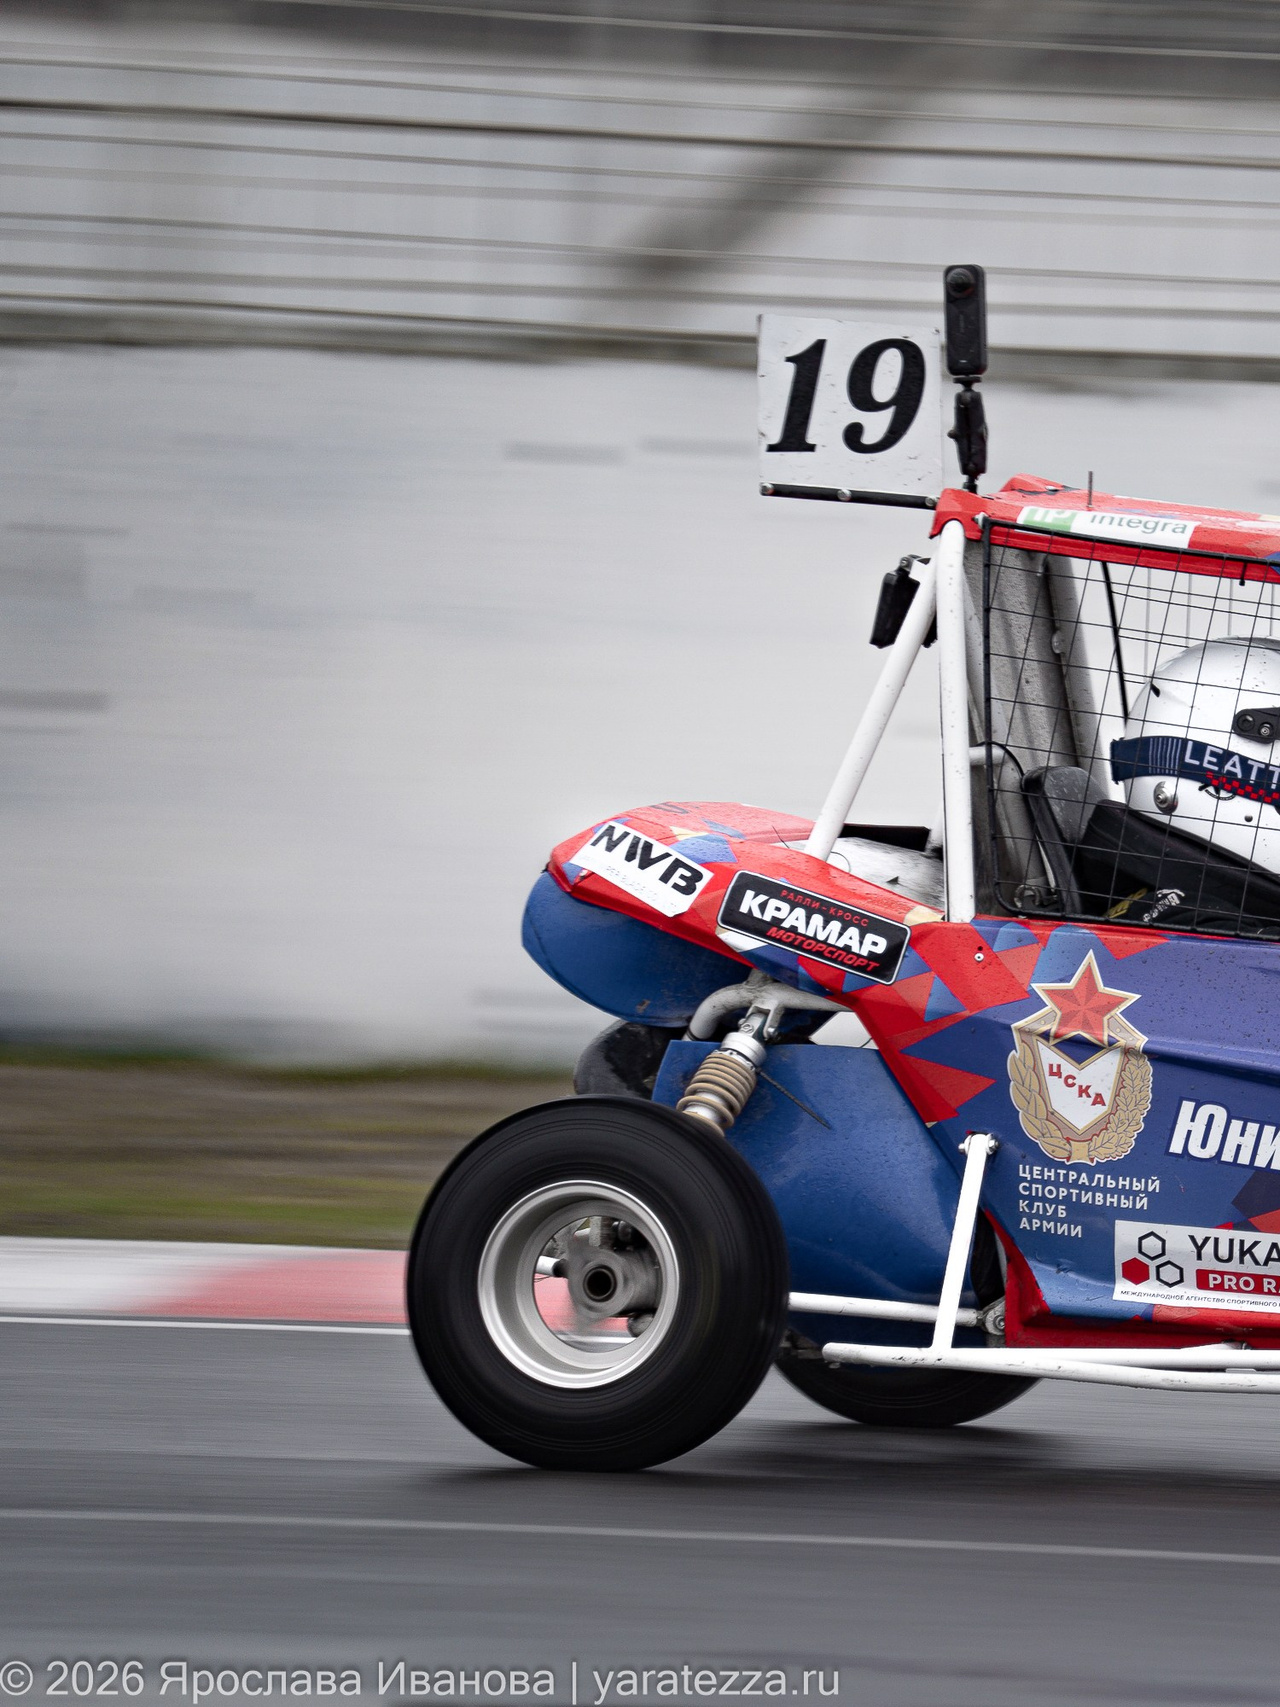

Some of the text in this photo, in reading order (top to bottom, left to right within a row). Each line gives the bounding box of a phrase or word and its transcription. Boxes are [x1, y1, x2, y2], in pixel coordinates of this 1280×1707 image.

[766, 338, 926, 454] 19
[739, 890, 888, 957] КРАМАР
[766, 926, 880, 972] МОТОРСПОРТ
[1048, 1063, 1107, 1107] ЦСКА
[1019, 1164, 1160, 1193] ЦЕНТРАЛЬНЫЙ
[1019, 1182, 1149, 1211] СПОРТИВНЫЙ
[1019, 1200, 1067, 1218] КЛУБ
[1019, 1217, 1083, 1238] АРМИИ
[1208, 1273, 1255, 1292] PRO
[1120, 1290, 1184, 1301] МЕЖДУНАРОДНОЕ
[1185, 1295, 1226, 1304] АГЕНТСТВО
[1226, 1298, 1278, 1308] СПОРТИВНОГО
